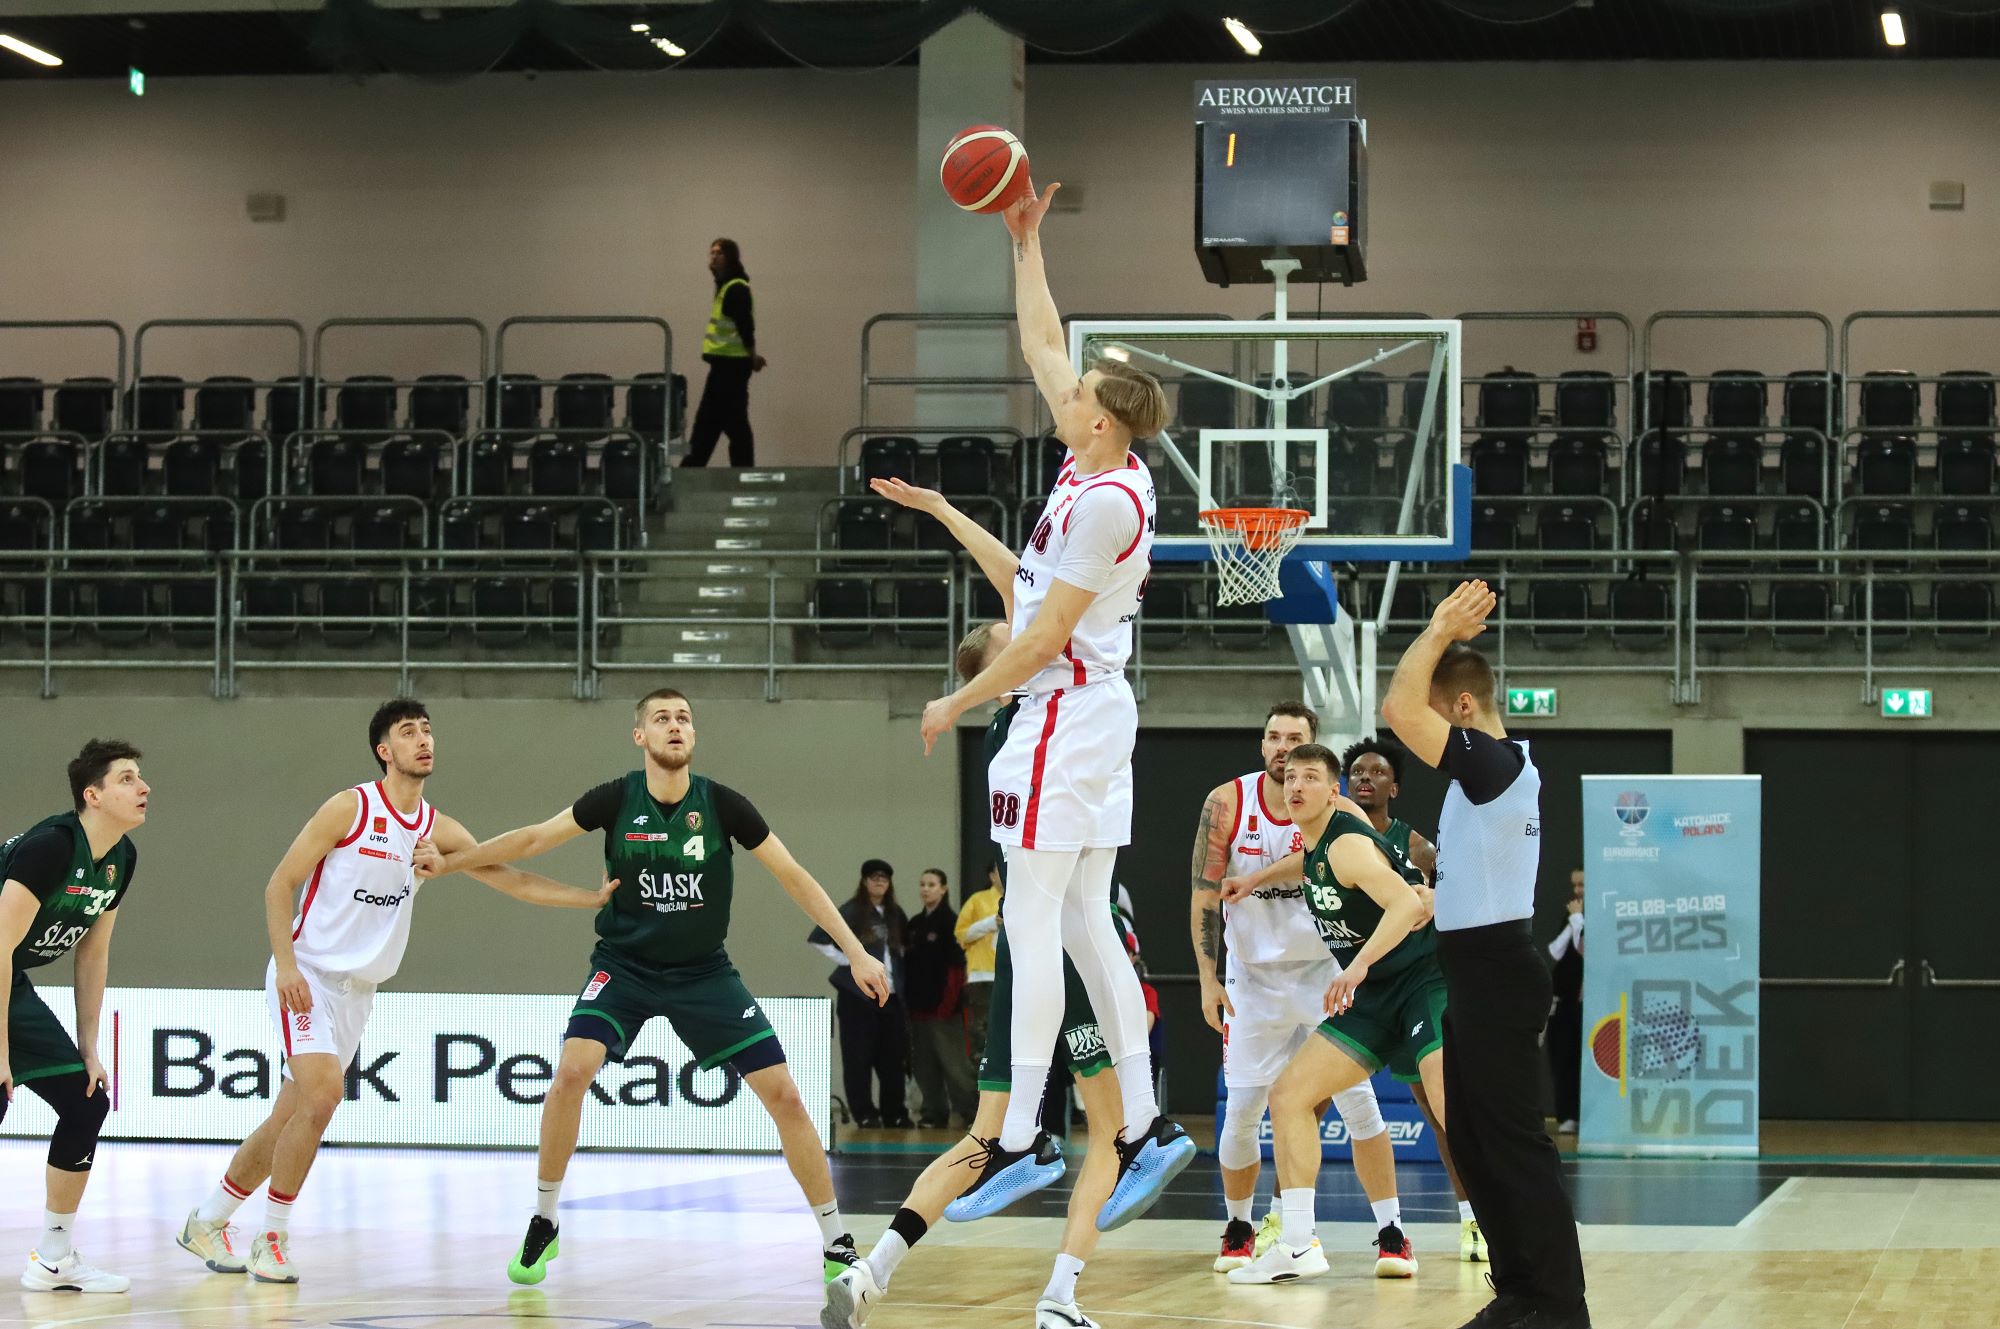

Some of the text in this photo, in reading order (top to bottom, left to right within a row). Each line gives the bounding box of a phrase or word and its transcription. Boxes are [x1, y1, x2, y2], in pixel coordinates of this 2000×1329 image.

[1198, 86, 1352, 106] AEROWATCH
[1287, 106, 1311, 114] SINCE
[633, 815, 649, 825] 4F
[991, 790, 1020, 829] 88
[1674, 813, 1732, 827] KATOWICE
[1682, 824, 1725, 837] POLAND
[683, 835, 705, 861] 4
[1603, 847, 1660, 858] EUROBASKET
[638, 868, 704, 901] ŚLĄSK
[655, 901, 688, 913] WROCŁAW
[1311, 885, 1343, 911] 26
[1309, 911, 1362, 939] LĄSK
[1616, 913, 1728, 956] 2025
[152, 1028, 401, 1102] Bak
